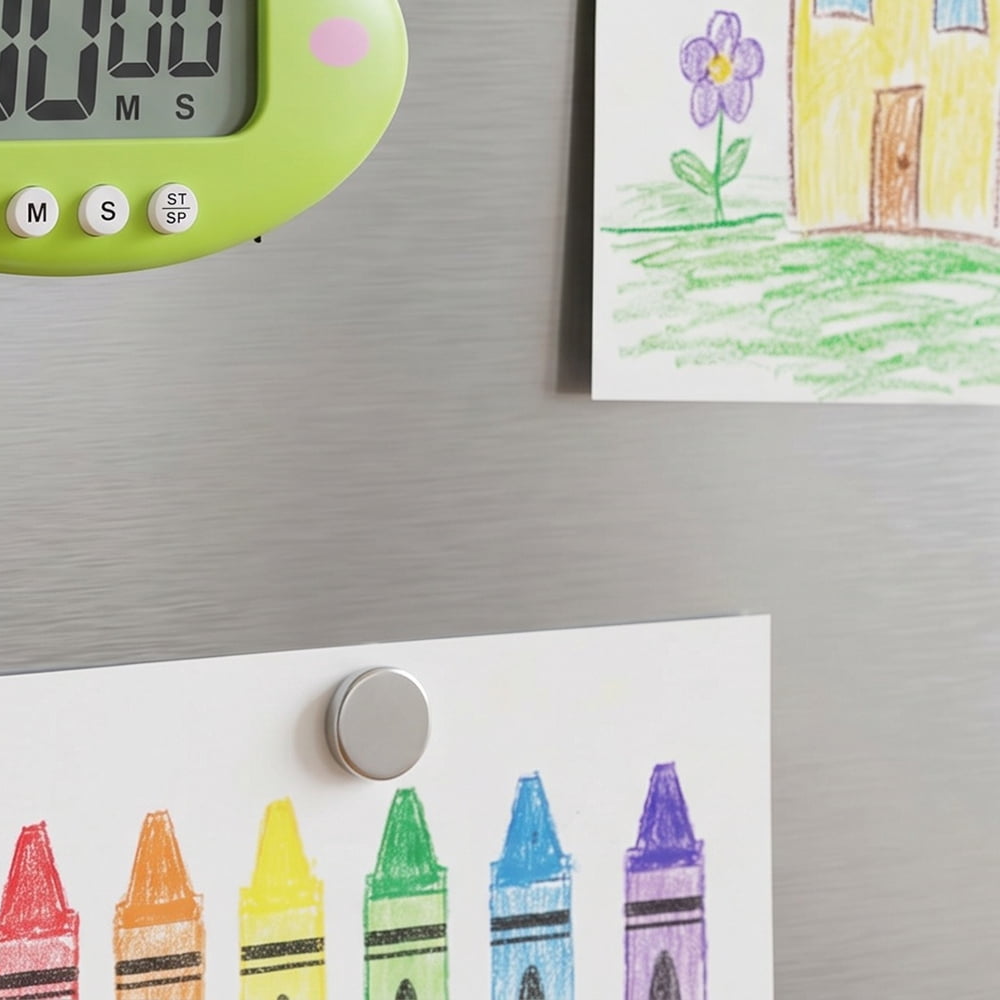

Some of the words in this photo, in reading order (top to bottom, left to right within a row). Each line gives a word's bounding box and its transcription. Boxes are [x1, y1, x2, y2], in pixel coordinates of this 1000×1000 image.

[115, 94, 140, 121] M
[175, 93, 195, 120] S
[167, 192, 187, 206] ST
[27, 202, 47, 223] M
[100, 200, 116, 221] S
[166, 211, 187, 225] SP
